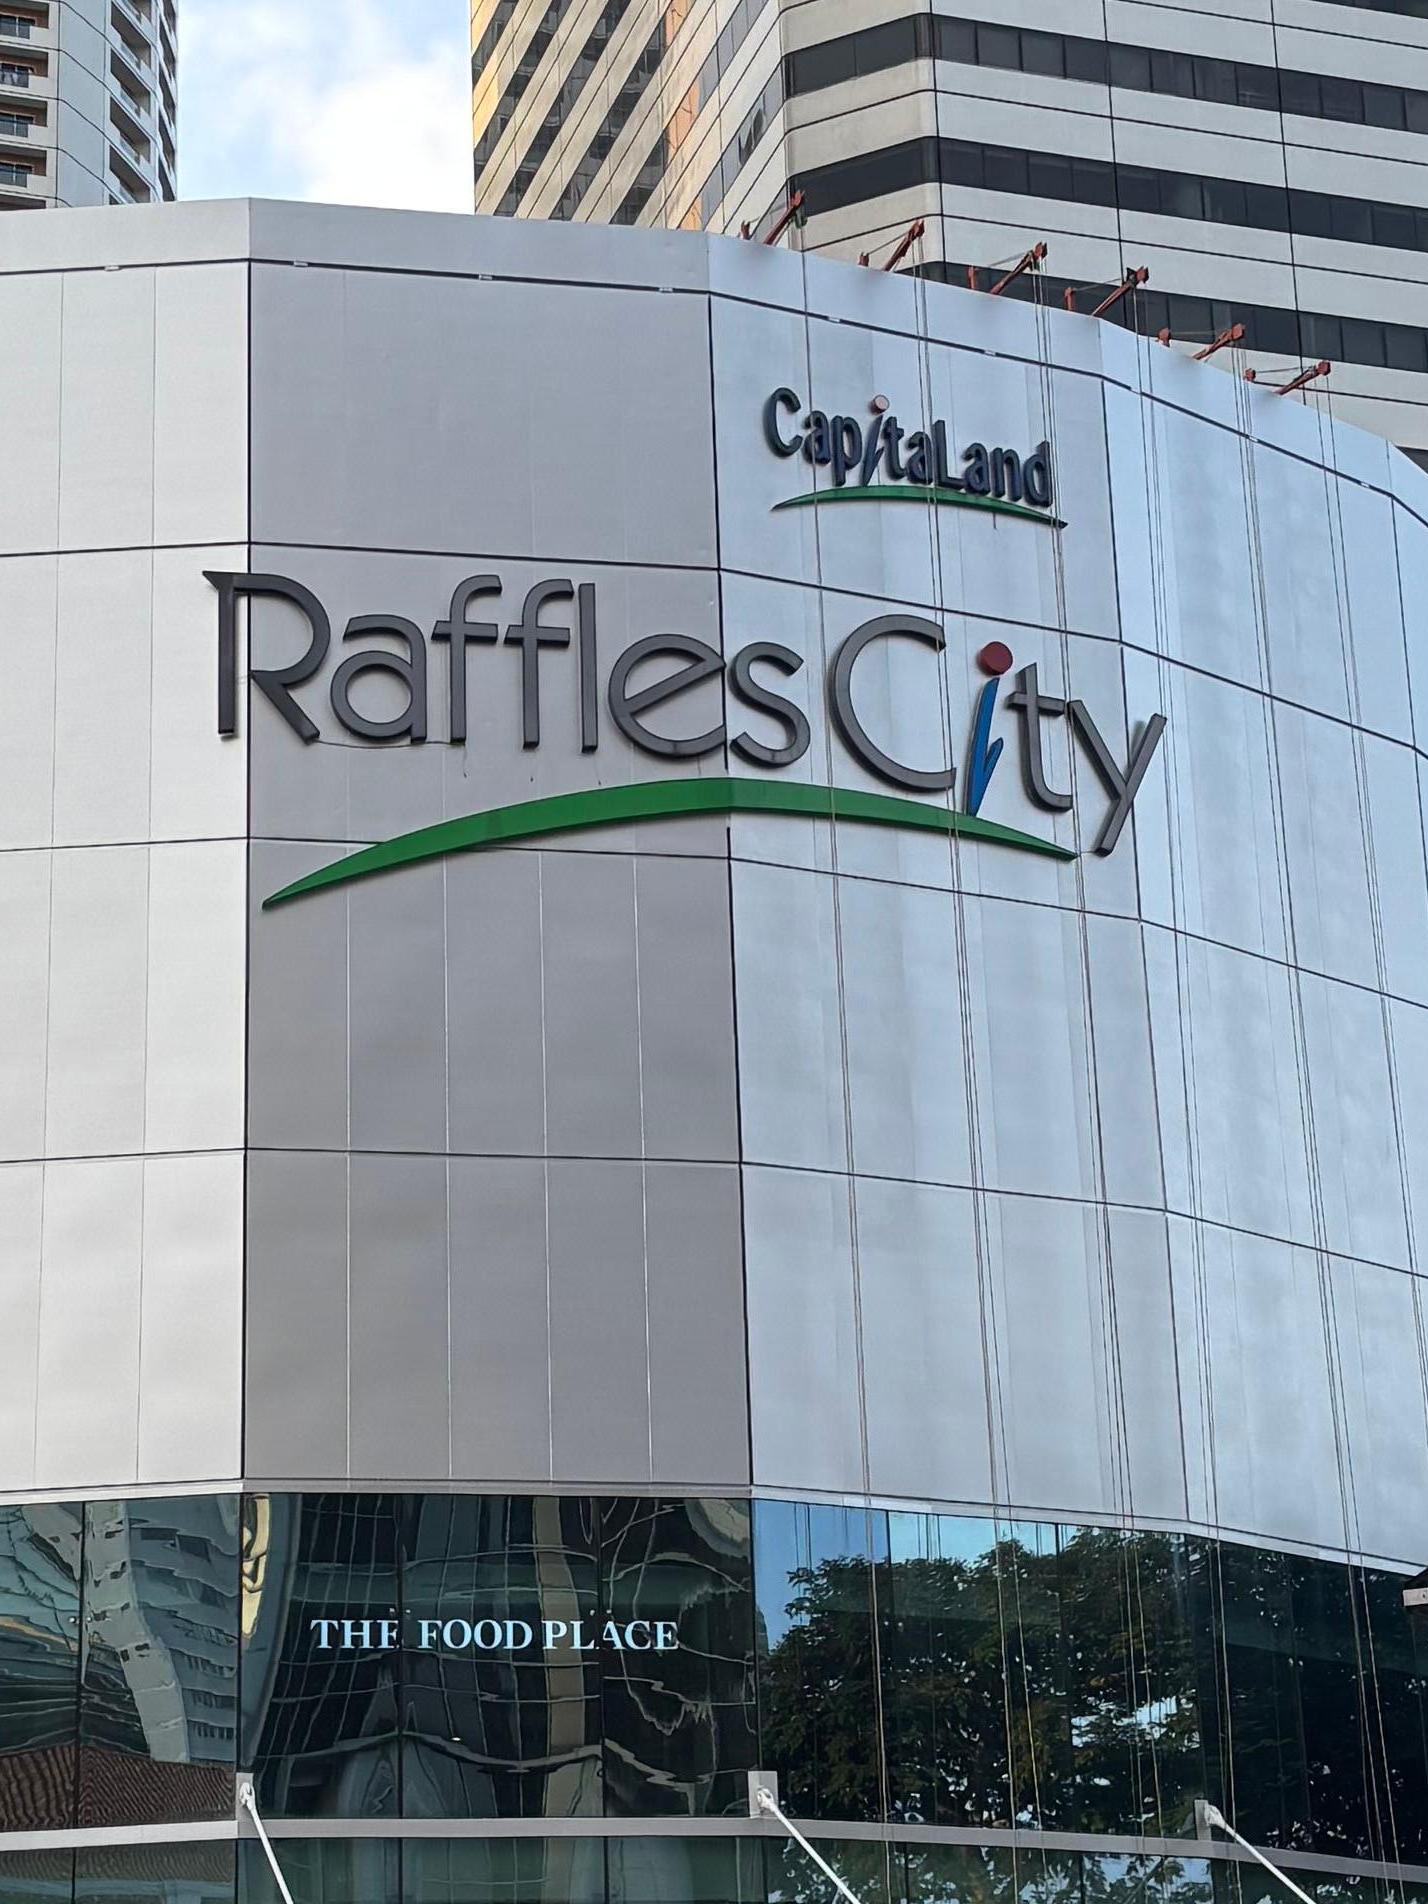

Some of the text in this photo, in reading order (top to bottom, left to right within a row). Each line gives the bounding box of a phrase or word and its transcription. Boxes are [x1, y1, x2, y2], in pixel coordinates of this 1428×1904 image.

[764, 386, 1054, 507] CapitaLand
[309, 1618, 680, 1651] THE FOOD PLACE
